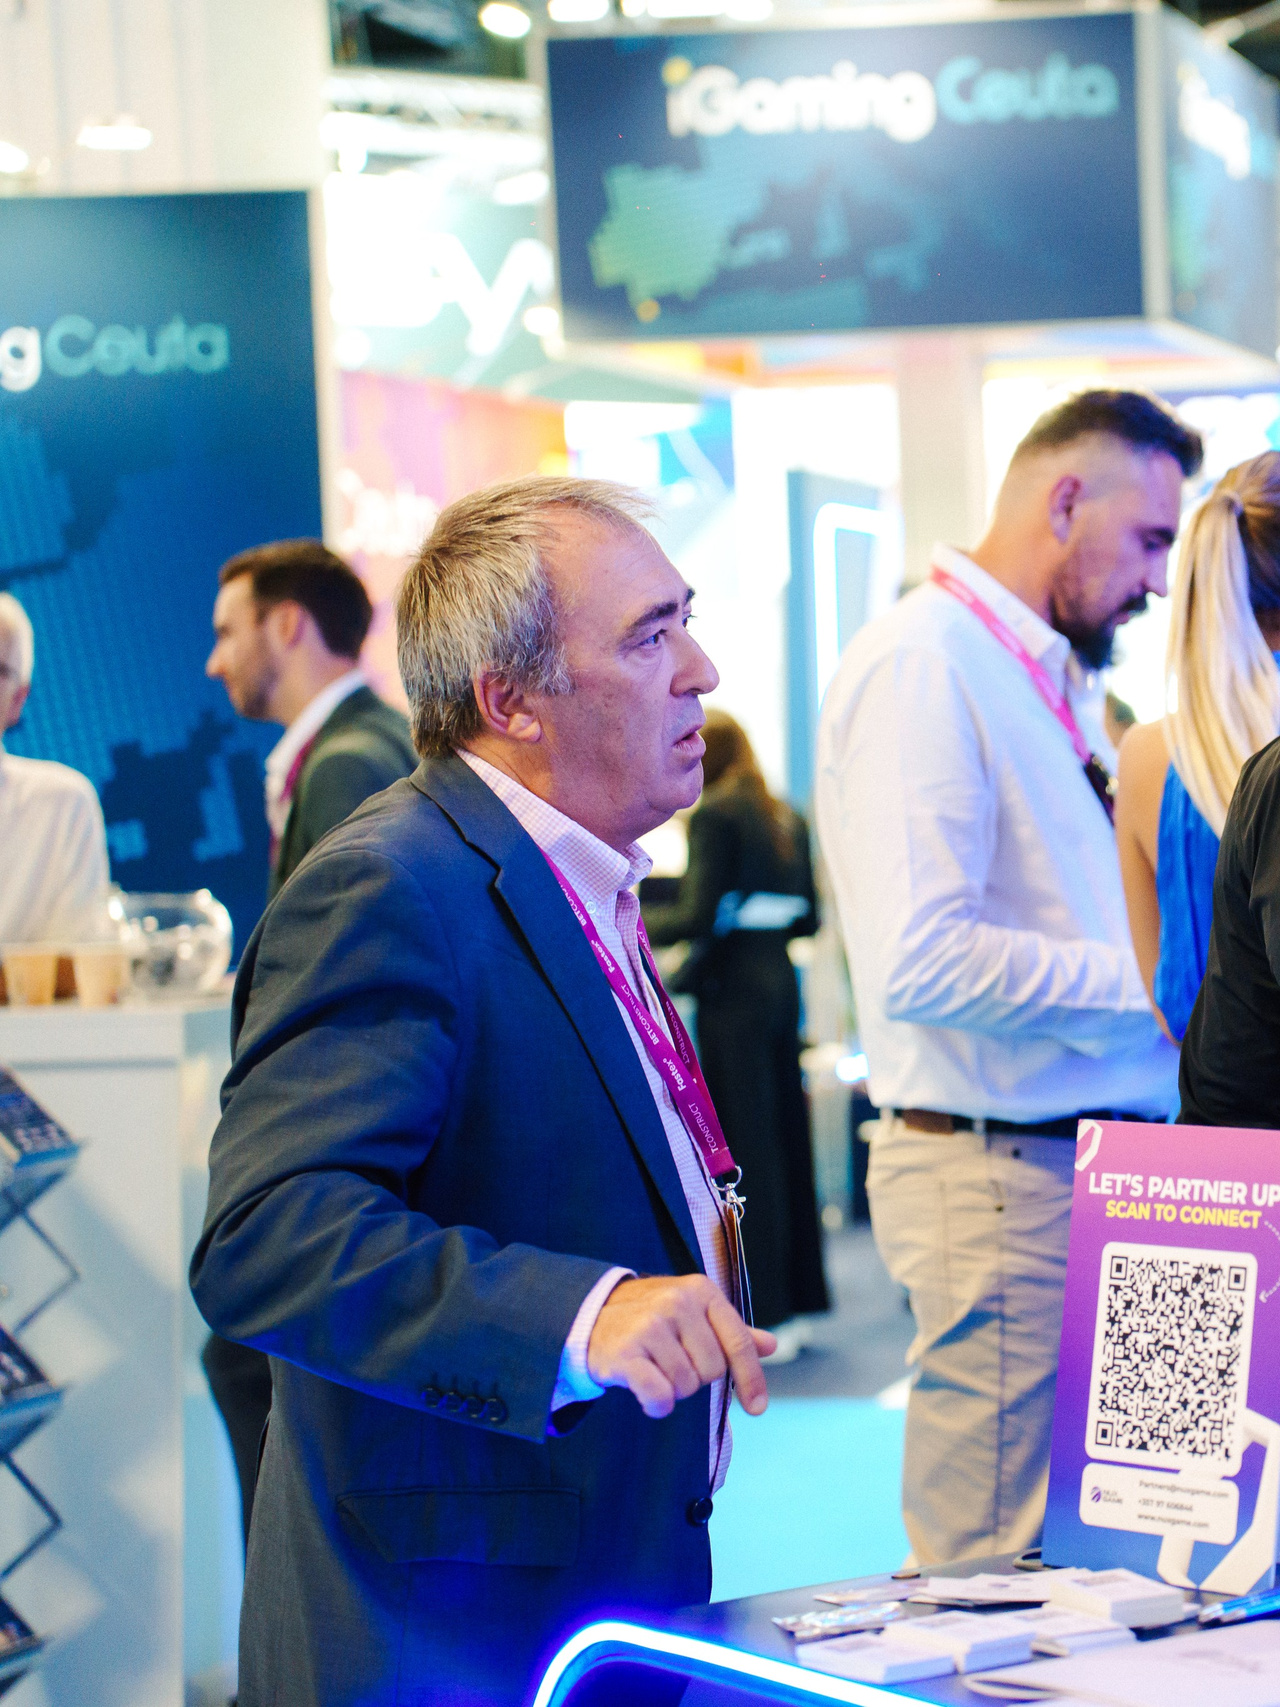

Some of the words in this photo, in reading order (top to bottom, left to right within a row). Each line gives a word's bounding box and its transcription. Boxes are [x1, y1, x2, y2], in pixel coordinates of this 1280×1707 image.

[663, 56, 937, 143] iGaming
[936, 51, 1119, 124] Ceuta
[621, 984, 660, 1046] BETCONSTRUCT
[665, 1001, 690, 1065] BETCONSTRUCT
[688, 1103, 719, 1154] TCONSTRUCT
[1089, 1172, 1144, 1197] LET'S
[1148, 1176, 1247, 1205] PARTNER
[1105, 1200, 1151, 1220] SCAN
[1153, 1203, 1177, 1222] TO
[1180, 1206, 1262, 1229] CONNECT
[1137, 1514, 1209, 1528] www.nuxgame.com
